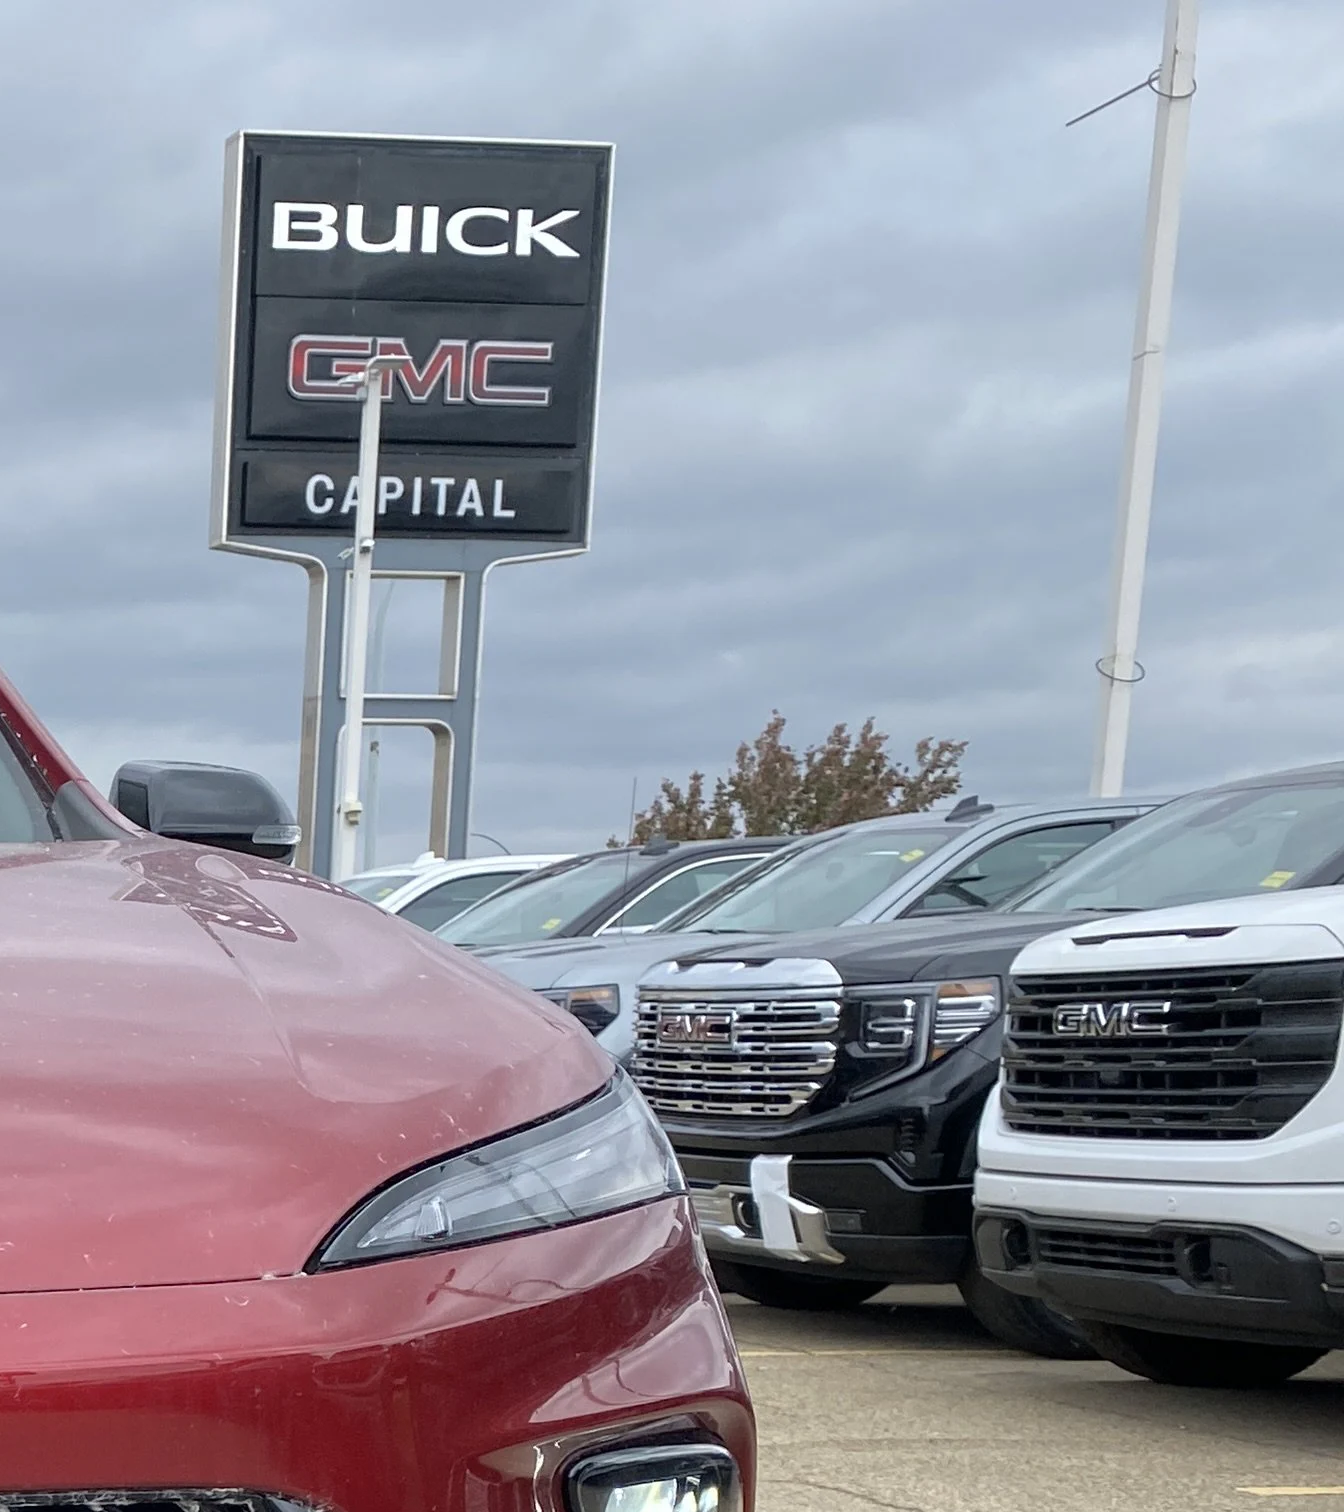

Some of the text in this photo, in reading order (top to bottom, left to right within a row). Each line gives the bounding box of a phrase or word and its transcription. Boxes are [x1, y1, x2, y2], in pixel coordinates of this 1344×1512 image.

[272, 202, 580, 257] BUICK
[287, 334, 554, 406] GMC
[305, 474, 516, 518] CAPITAL
[659, 1014, 731, 1041] GMC
[1053, 1001, 1172, 1036] GMC
